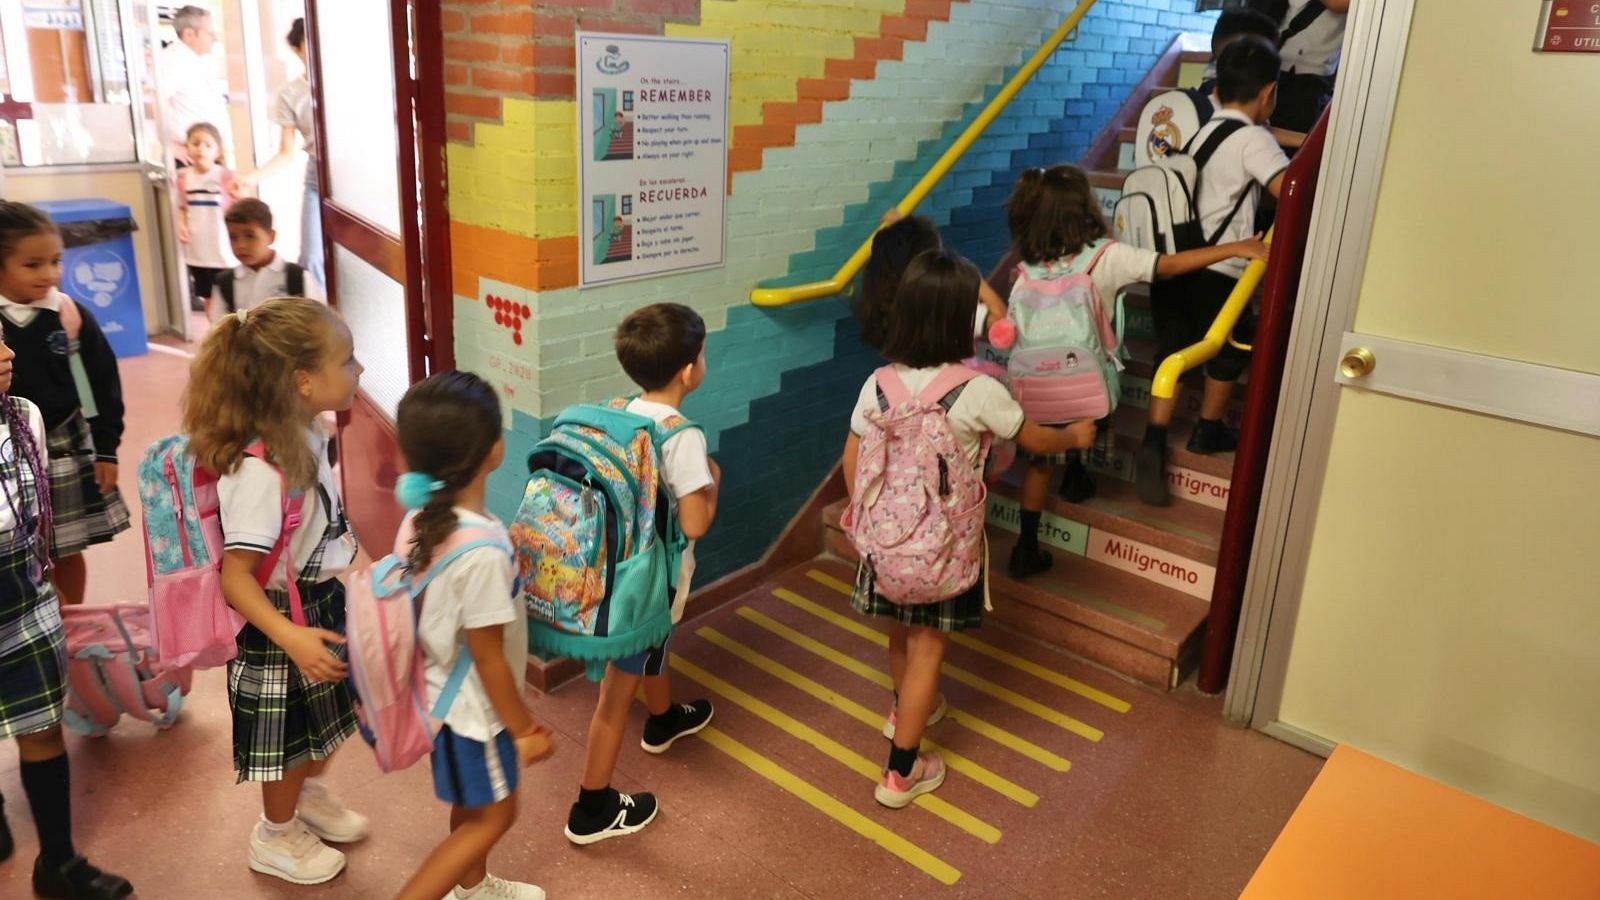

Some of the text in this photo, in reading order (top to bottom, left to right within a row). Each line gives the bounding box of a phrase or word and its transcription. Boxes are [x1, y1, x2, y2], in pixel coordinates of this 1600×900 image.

[1574, 37, 1600, 47] UTIL
[640, 77, 649, 85] On
[651, 77, 661, 85] the
[640, 89, 712, 103] REMEMBER
[661, 113, 679, 121] walking
[669, 152, 680, 160] your
[639, 186, 707, 203] RECUERDA
[1104, 539, 1198, 584] Miligramo
